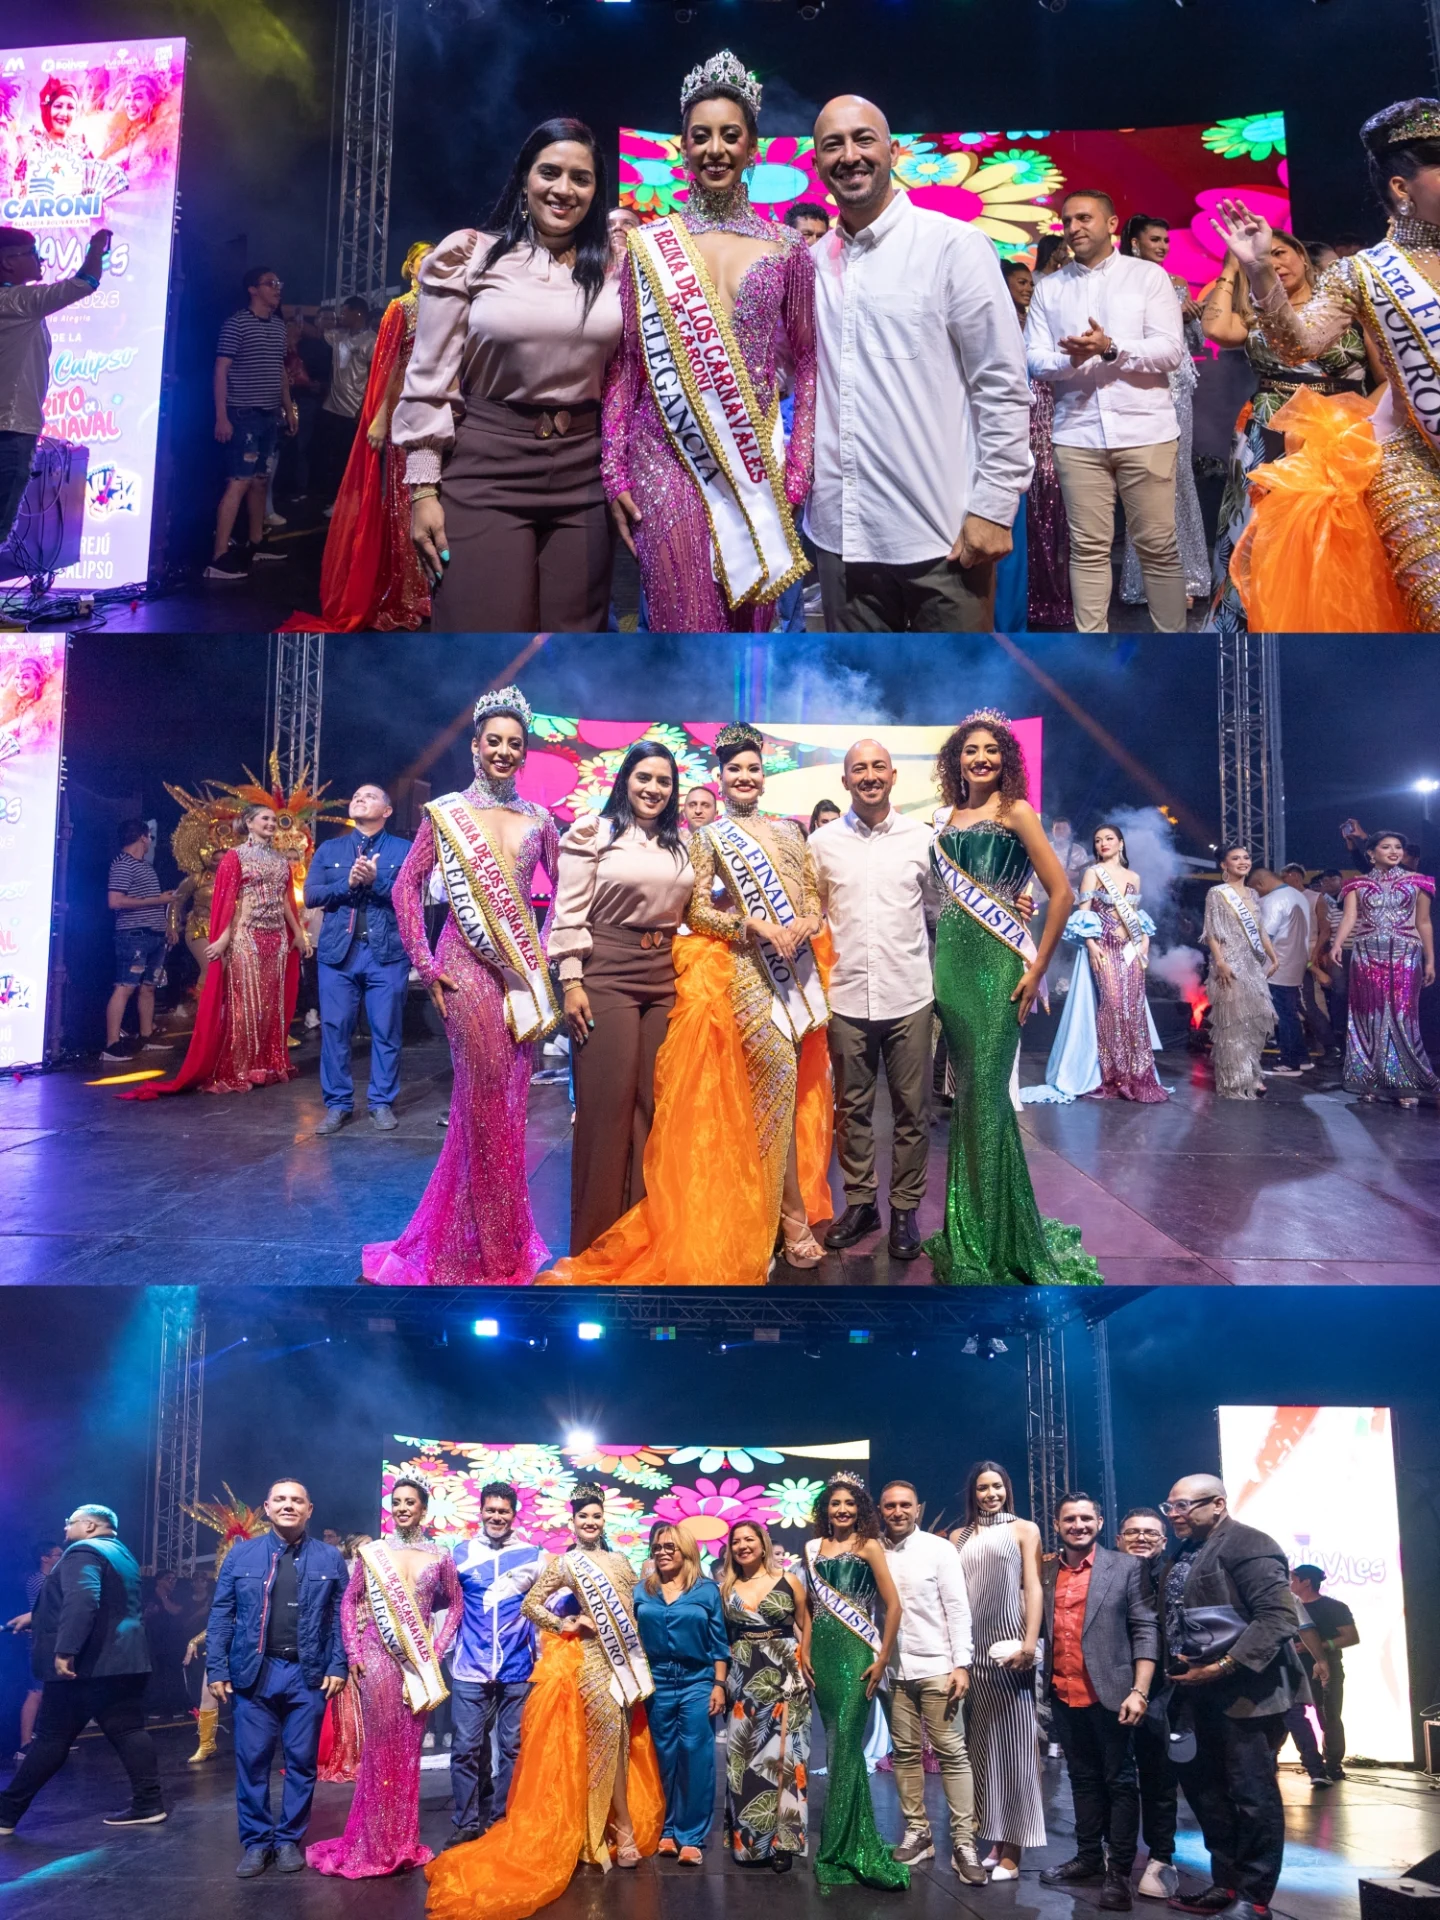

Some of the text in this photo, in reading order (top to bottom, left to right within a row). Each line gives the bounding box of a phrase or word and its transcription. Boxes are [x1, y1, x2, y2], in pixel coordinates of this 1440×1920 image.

[4, 191, 101, 219] CARONÍ
[653, 229, 689, 277] REINA
[675, 274, 703, 305] DE
[51, 332, 82, 343] DE LA
[666, 293, 714, 392] DE CARONI
[688, 304, 719, 344] LOS
[53, 348, 138, 384] Calipso
[642, 312, 720, 486] ELEGANCIA
[704, 344, 768, 484] CARNAVALES
[58, 560, 114, 580] ALIPSO
[449, 807, 541, 972] REINA DE LOS CARNAVALES
[467, 856, 506, 920] DE CARONI
[936, 854, 1025, 949] FINALISTA
[1237, 901, 1258, 938] MEJOR
[373, 1549, 393, 1574] REINA
[387, 1572, 400, 1587] DE
[394, 1585, 407, 1604] LOS
[402, 1602, 431, 1663] CARNAVALES
[591, 1600, 626, 1667] ROSTRO
[593, 1572, 640, 1652] FINALISTA
[812, 1577, 877, 1643] FINALISTA
